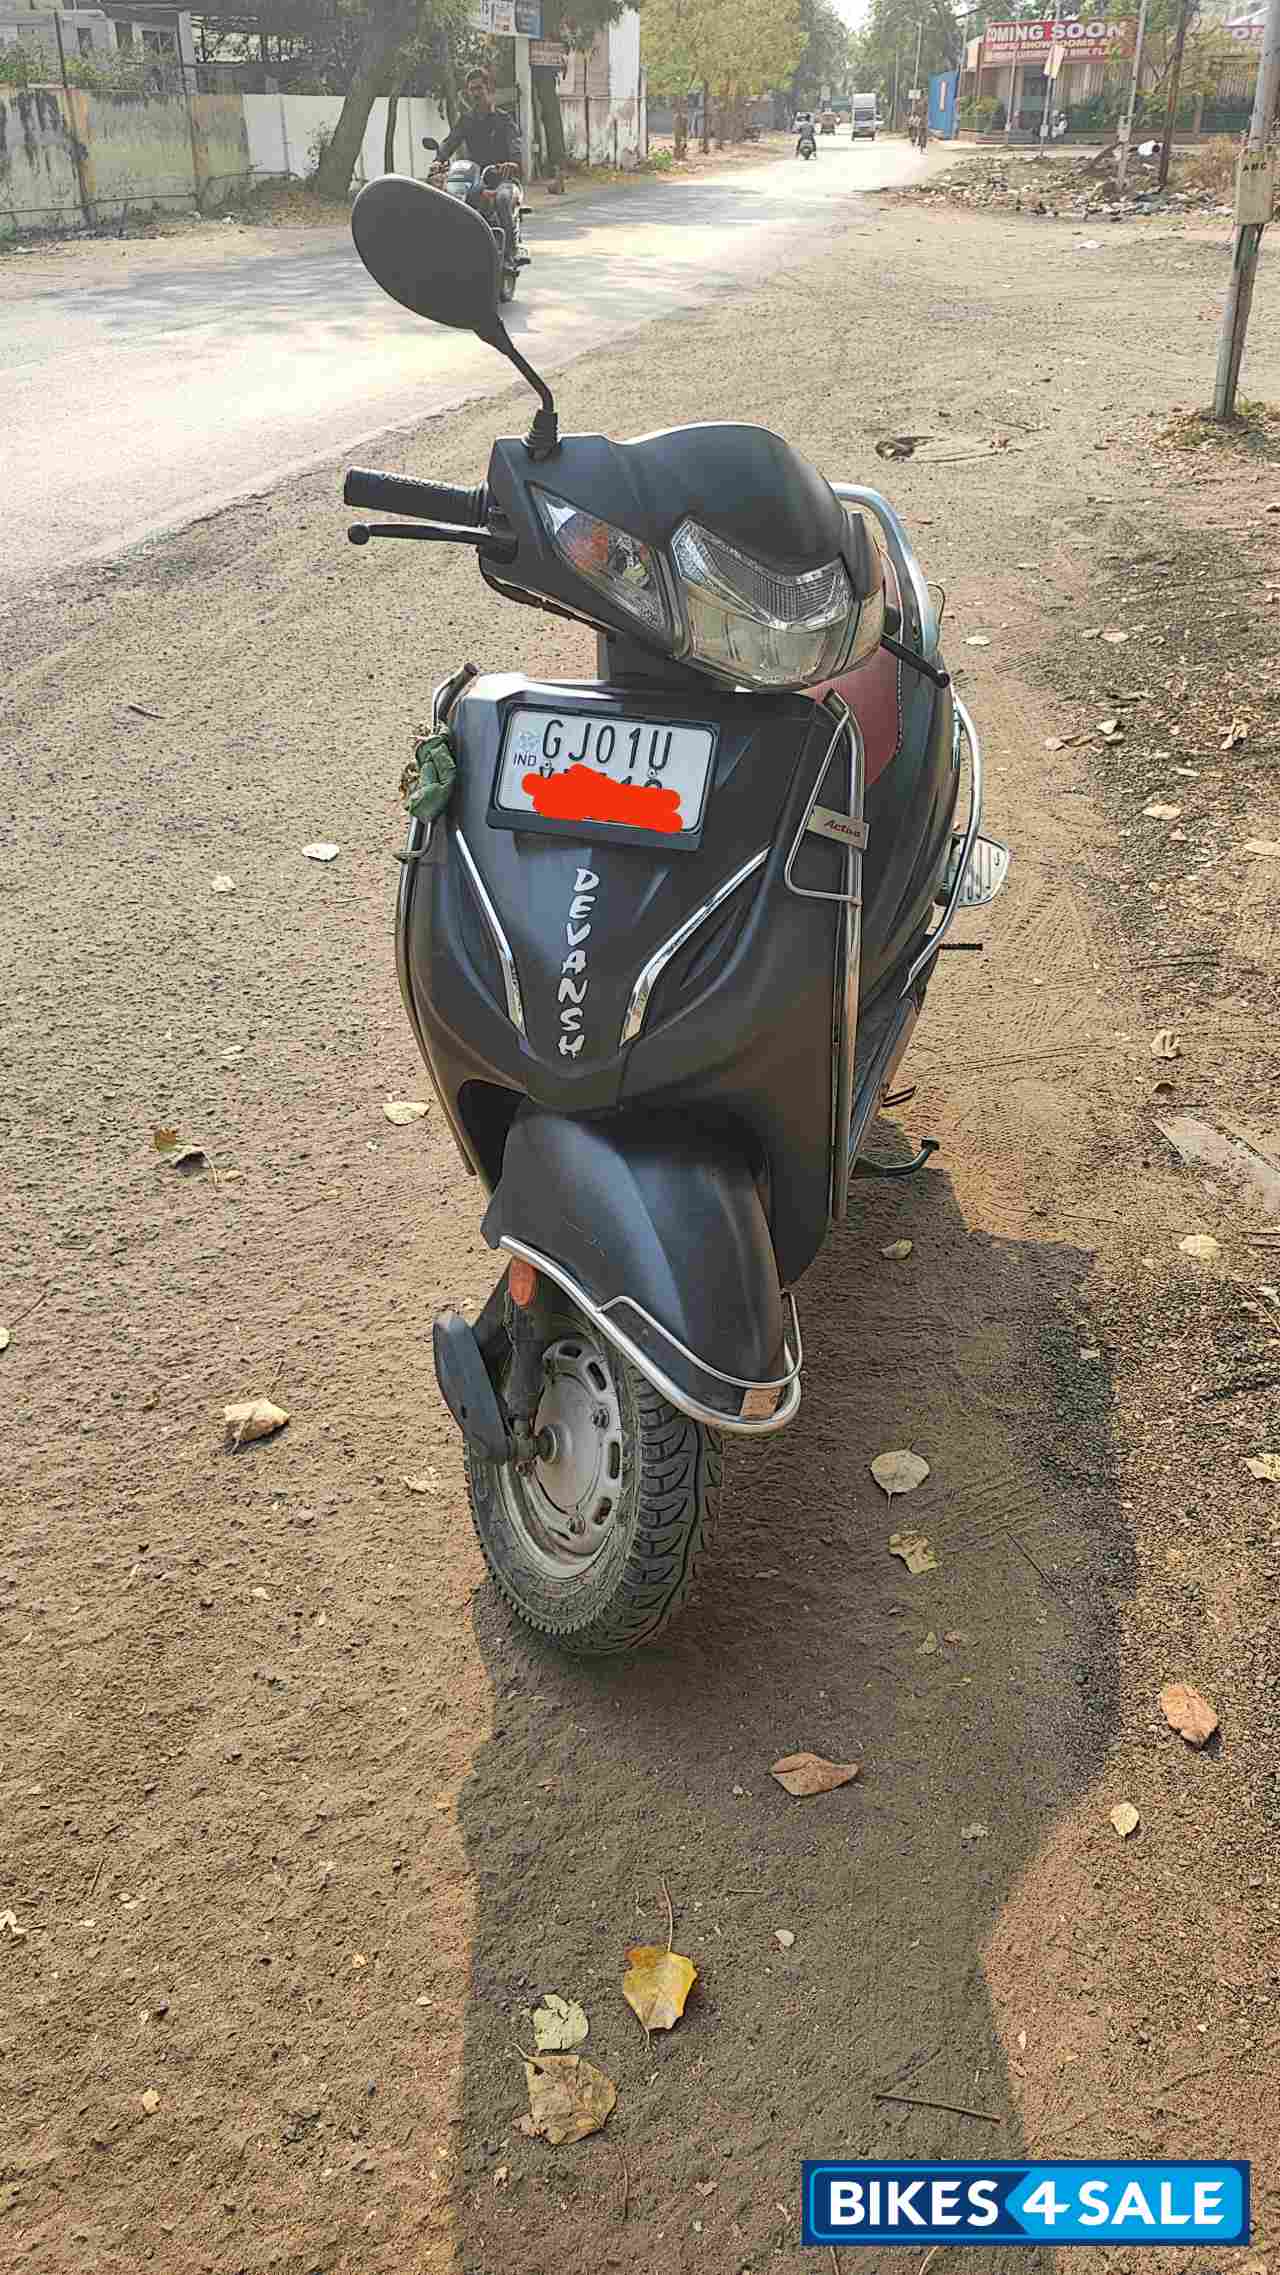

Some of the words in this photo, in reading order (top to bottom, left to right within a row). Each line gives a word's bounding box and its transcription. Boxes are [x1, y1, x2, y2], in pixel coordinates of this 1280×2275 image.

[1052, 21, 1121, 40] SOON
[512, 752, 538, 768] IND
[556, 866, 600, 1059] DEVANSH
